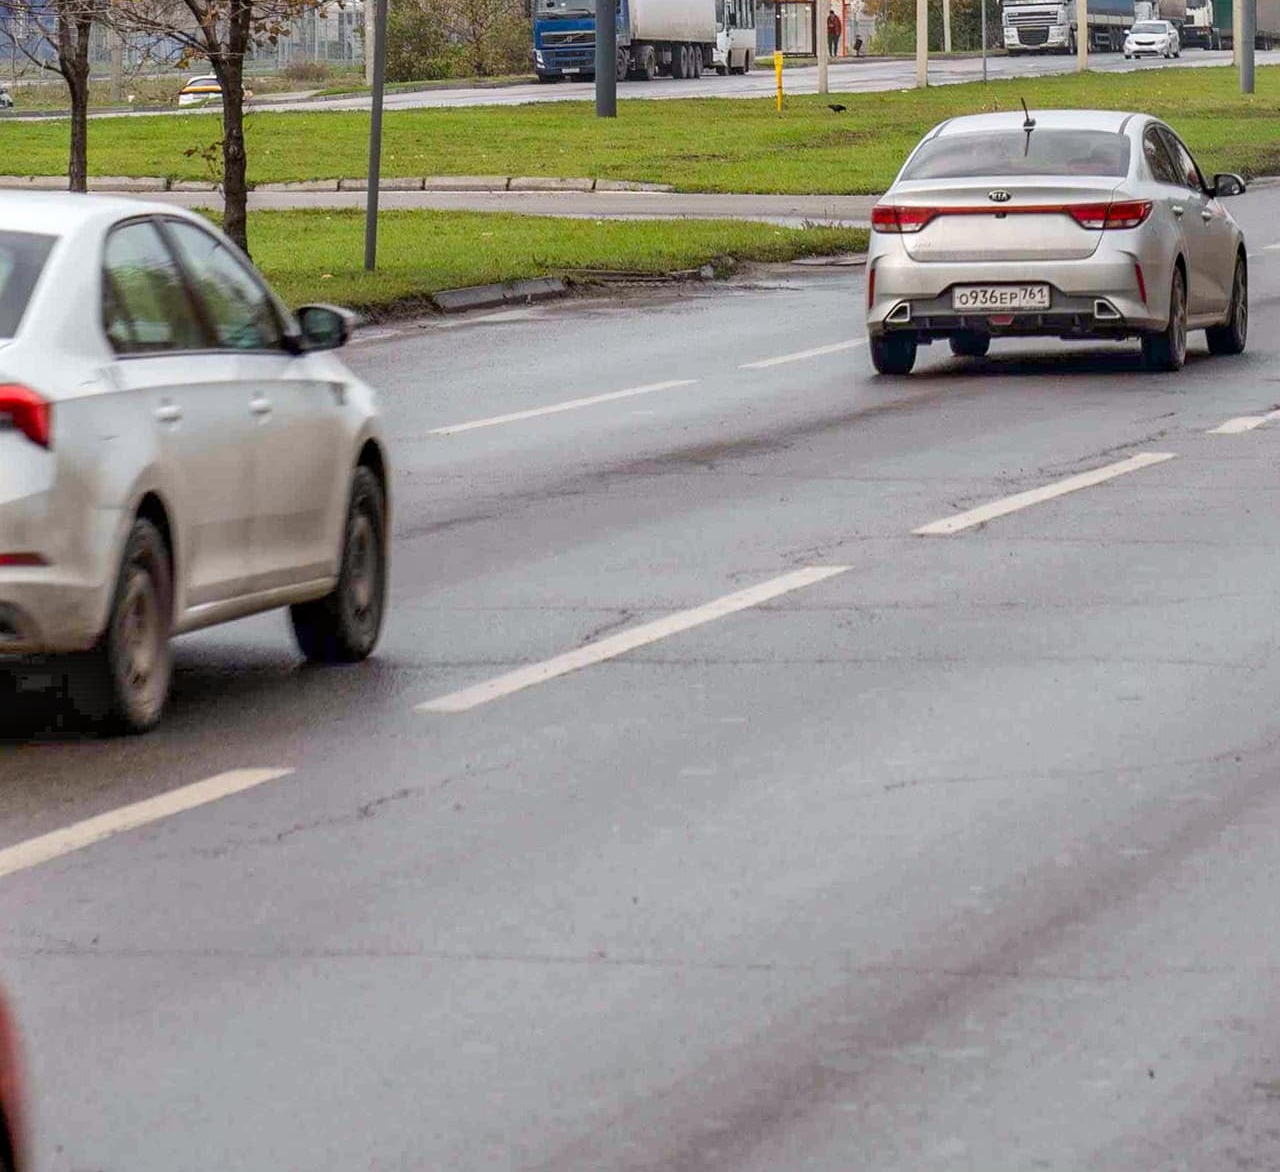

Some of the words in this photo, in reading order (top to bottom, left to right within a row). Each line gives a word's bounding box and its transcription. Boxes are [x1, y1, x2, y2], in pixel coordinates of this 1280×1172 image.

[990, 191, 1009, 201] KIA
[959, 290, 1018, 305] О936ЕР
[1022, 288, 1045, 301] 761
